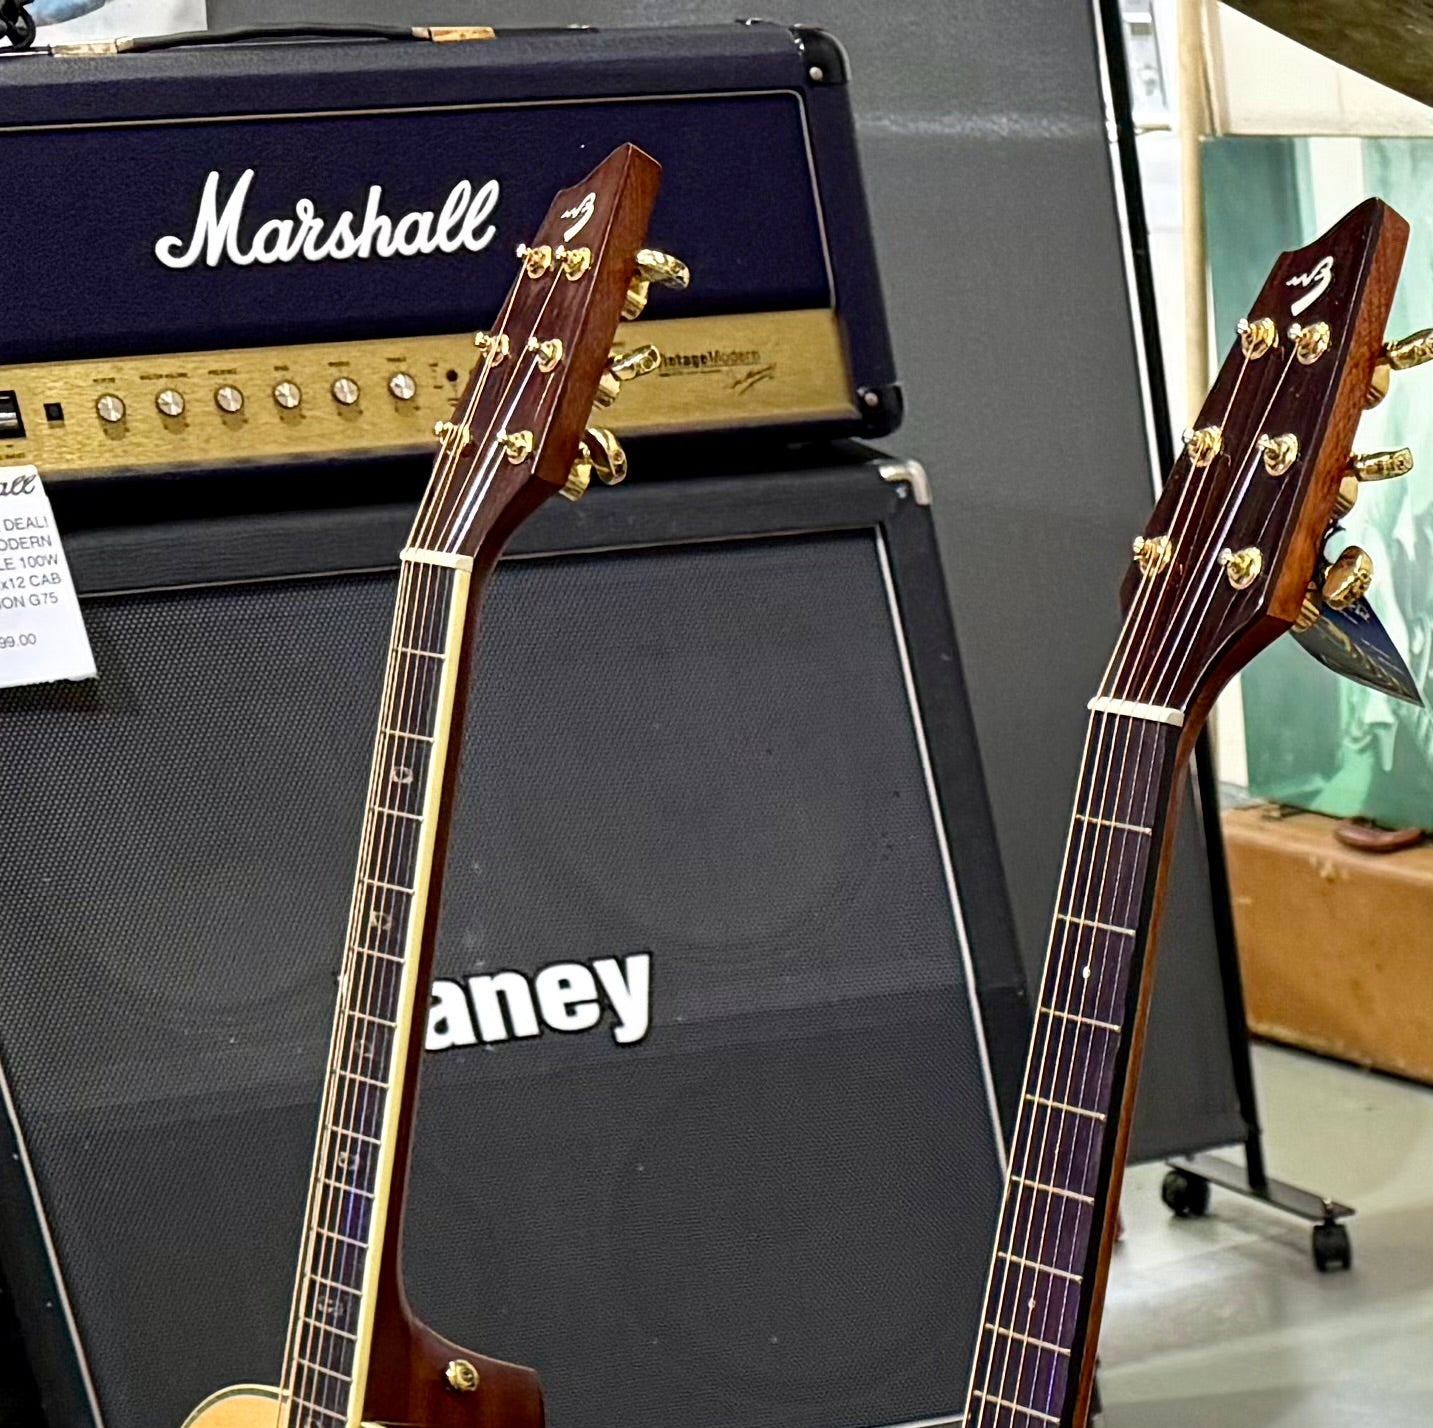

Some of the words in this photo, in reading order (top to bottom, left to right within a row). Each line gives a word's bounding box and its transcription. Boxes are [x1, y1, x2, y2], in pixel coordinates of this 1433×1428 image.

[155, 168, 500, 269] Marshall
[659, 349, 761, 369] intageModern
[0, 535, 52, 552] ODERN
[20, 554, 59, 568] 100W
[1, 576, 26, 591] x12
[29, 572, 62, 588] CAB
[424, 953, 652, 1051] aney
